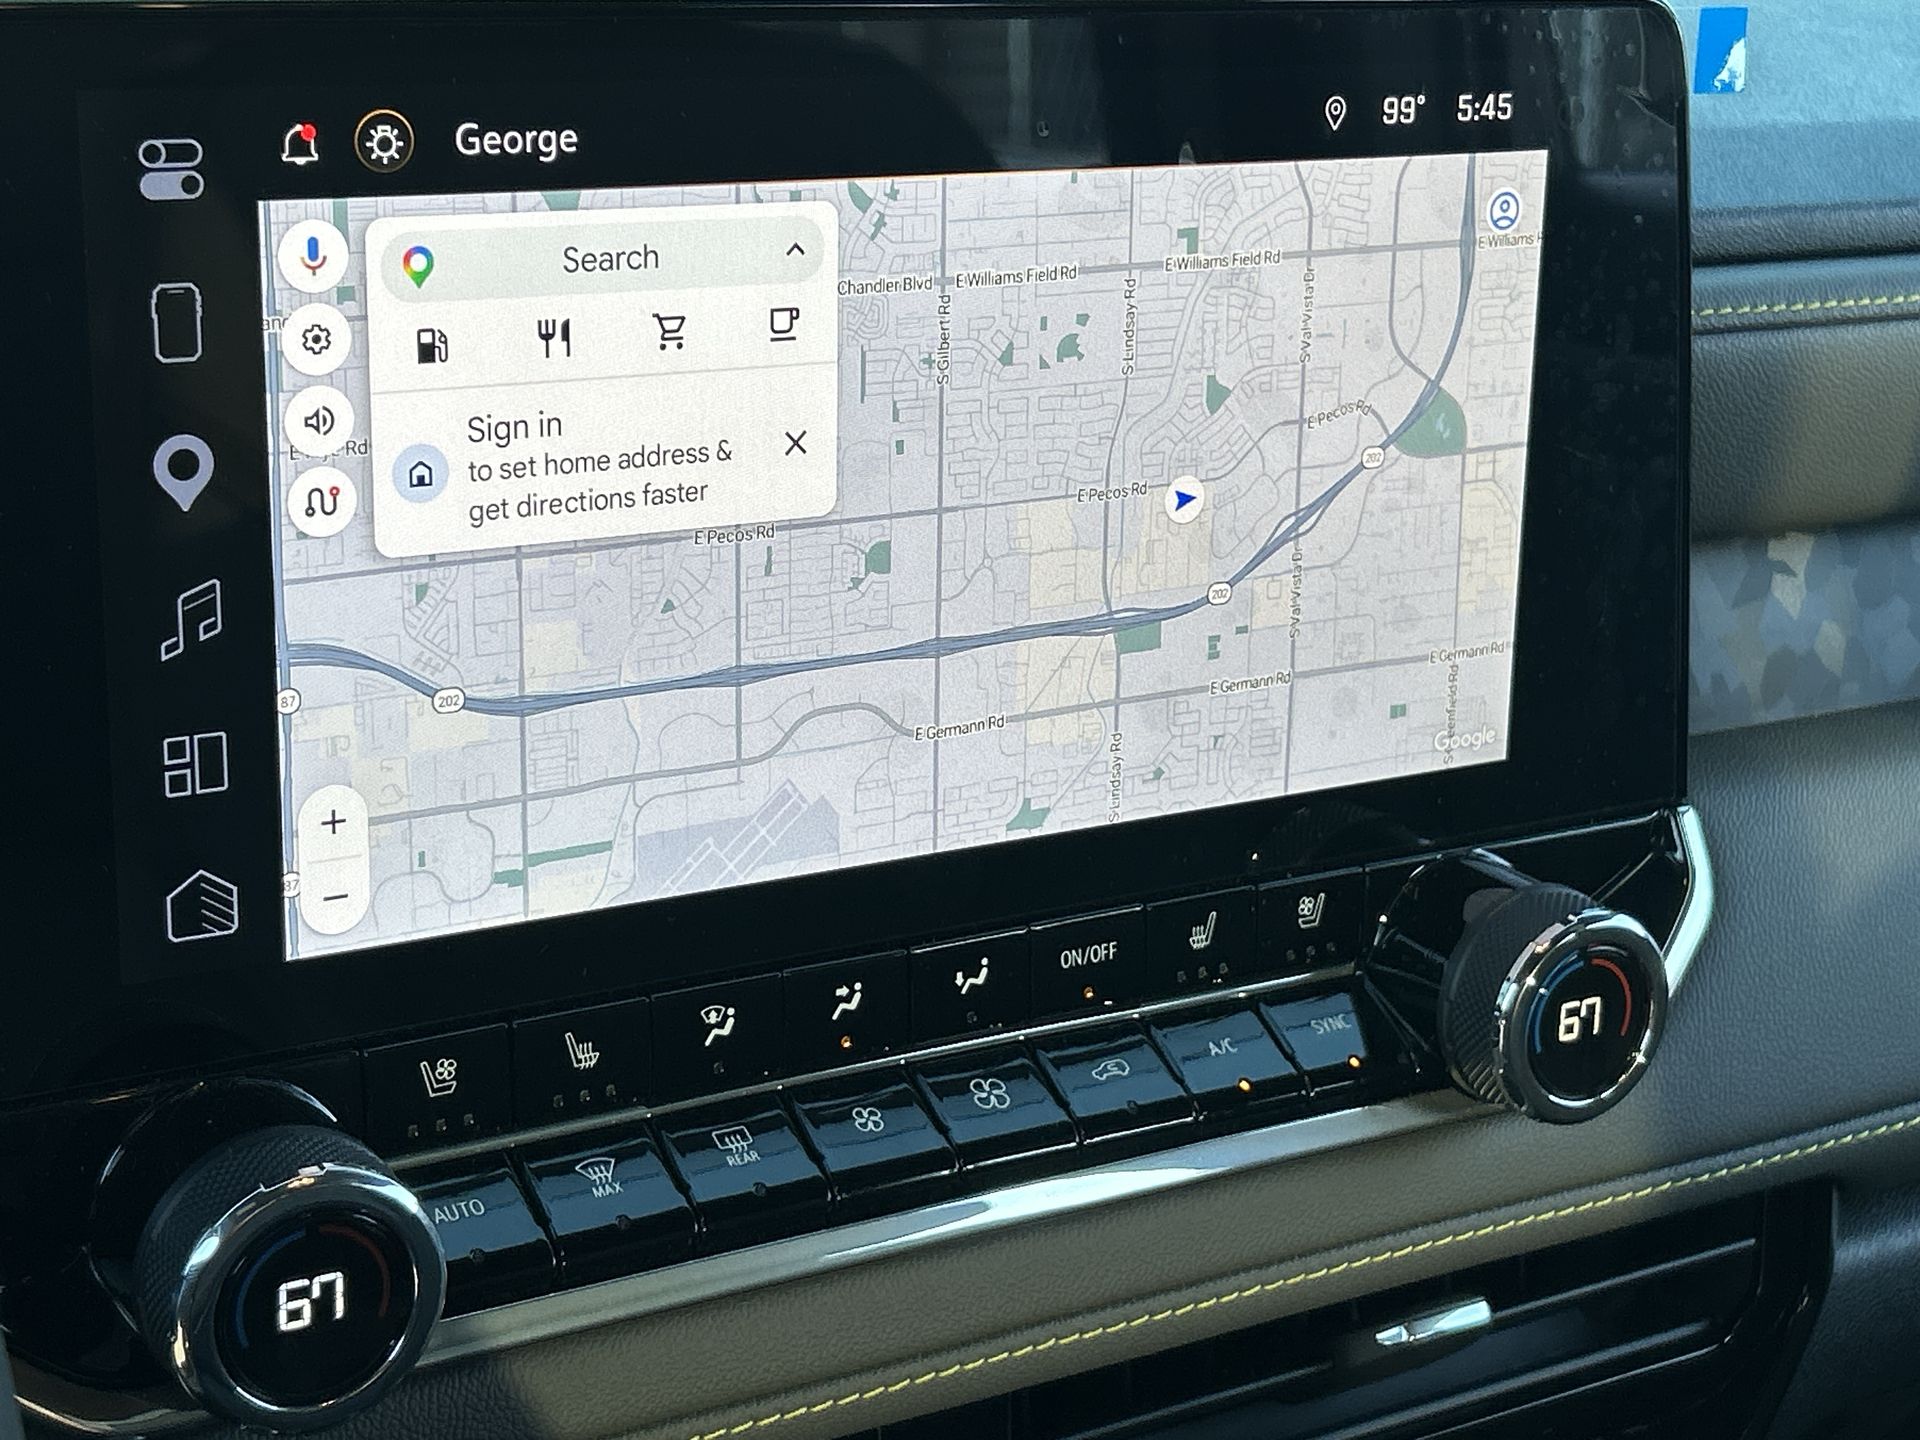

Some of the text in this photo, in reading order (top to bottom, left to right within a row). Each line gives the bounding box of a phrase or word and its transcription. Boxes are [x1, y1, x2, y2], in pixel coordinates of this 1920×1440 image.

[1382, 94, 1426, 125] 99°
[1457, 94, 1513, 121] 5:45
[454, 121, 579, 161] George
[1478, 235, 1487, 250] E
[1488, 232, 1535, 248] Williams
[562, 244, 660, 274] Search
[1165, 251, 1281, 272] E Williams Field Rd
[837, 275, 933, 296] Chandler Blvd
[956, 265, 1077, 289] E Williams Field Rd
[1122, 278, 1137, 376] S Lindsay Rd
[1300, 267, 1315, 363] S Val Vista Dr
[937, 295, 951, 385] S Gilbert Rd
[1308, 399, 1373, 430] E Pecos Rd
[467, 411, 562, 447] Sign in
[345, 439, 369, 457] Rd
[468, 441, 733, 482] to set home address &
[1364, 451, 1382, 464] 202
[468, 482, 708, 528] get directions faster
[1078, 482, 1148, 501] E Pecos Rd
[694, 523, 775, 545] E Pecos Rd
[1211, 587, 1229, 600] 202
[1290, 545, 1303, 638] S Val Vista Dr
[1430, 641, 1505, 664] E Germann Rd
[1211, 670, 1291, 694] E Germann Rd
[280, 696, 296, 708] 87
[438, 694, 460, 708] 202
[1443, 664, 1458, 764] S eenfield Rd
[916, 715, 1005, 742] E Germann Rd
[1433, 725, 1497, 751] Google
[1109, 732, 1124, 823] S Lindsay Rd
[1060, 941, 1118, 969] ON/OFF
[1310, 1013, 1350, 1035] SYNC
[1557, 996, 1602, 1044] 67
[1208, 1038, 1238, 1057] A/C
[726, 1151, 761, 1168] REAR
[592, 1182, 625, 1198] MAX
[434, 1198, 485, 1226] AUTO
[276, 1272, 344, 1332] 67
